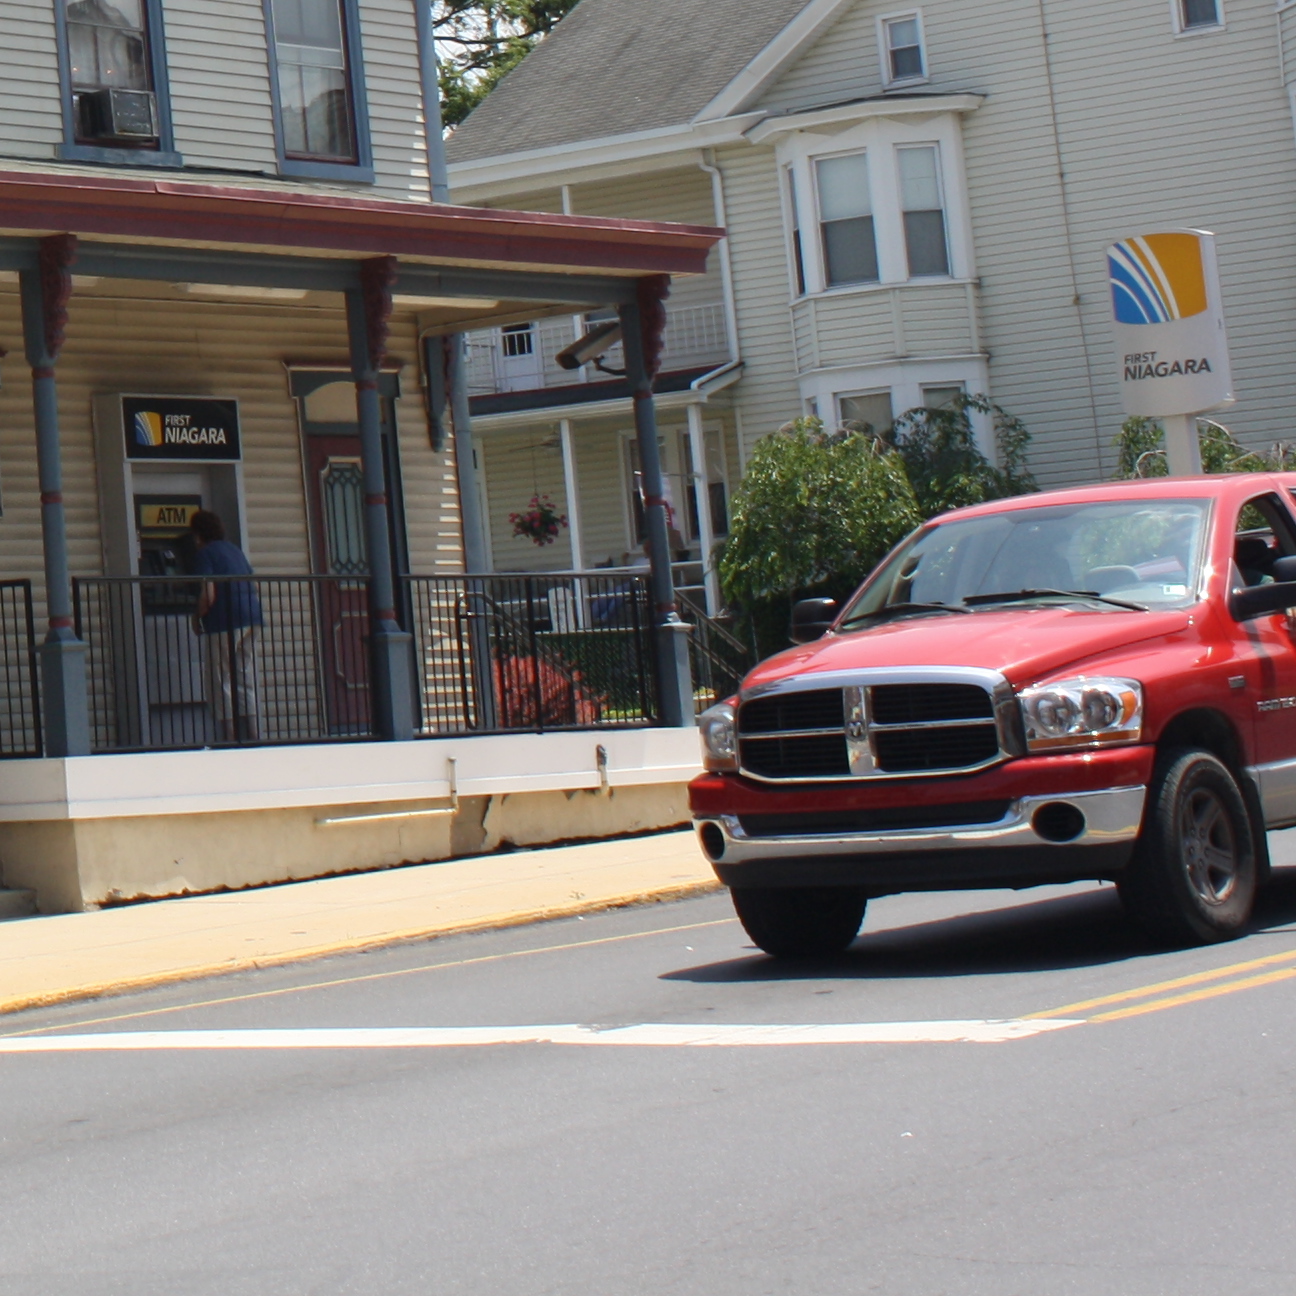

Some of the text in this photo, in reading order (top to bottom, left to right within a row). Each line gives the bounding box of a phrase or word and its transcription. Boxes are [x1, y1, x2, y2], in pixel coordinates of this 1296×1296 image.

[1124, 351, 1157, 364] FIRST
[1124, 357, 1211, 381] NIAGARA
[165, 414, 191, 426] FIRST
[165, 427, 227, 444] NIAGARA
[156, 507, 186, 524] ATM
